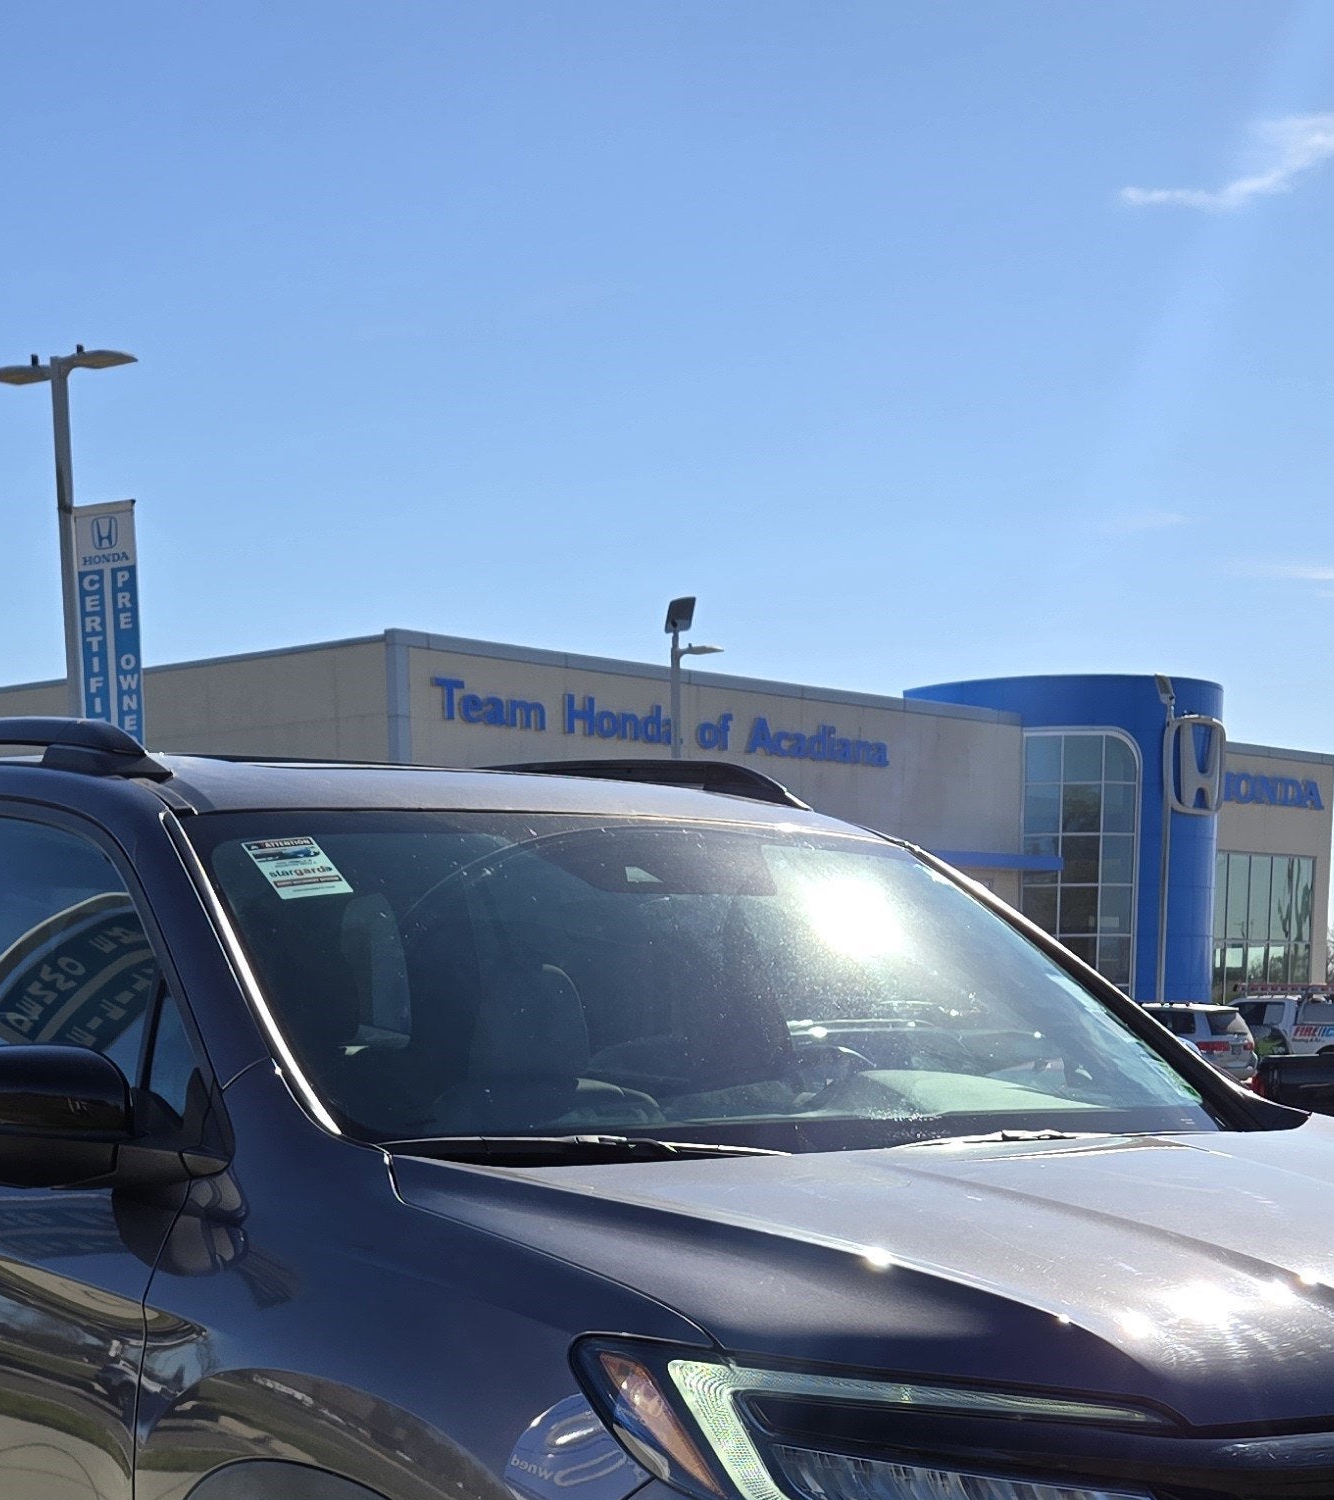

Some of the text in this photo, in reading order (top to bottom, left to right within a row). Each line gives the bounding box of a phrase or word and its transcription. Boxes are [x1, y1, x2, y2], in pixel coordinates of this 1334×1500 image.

[82, 551, 131, 567] HONDA
[82, 574, 106, 723] CERTIFI
[116, 570, 140, 742] PRE OWNE
[431, 676, 547, 732] Team
[695, 713, 734, 751] of
[747, 717, 891, 768] Acadiana
[264, 839, 311, 849] ATTENTION
